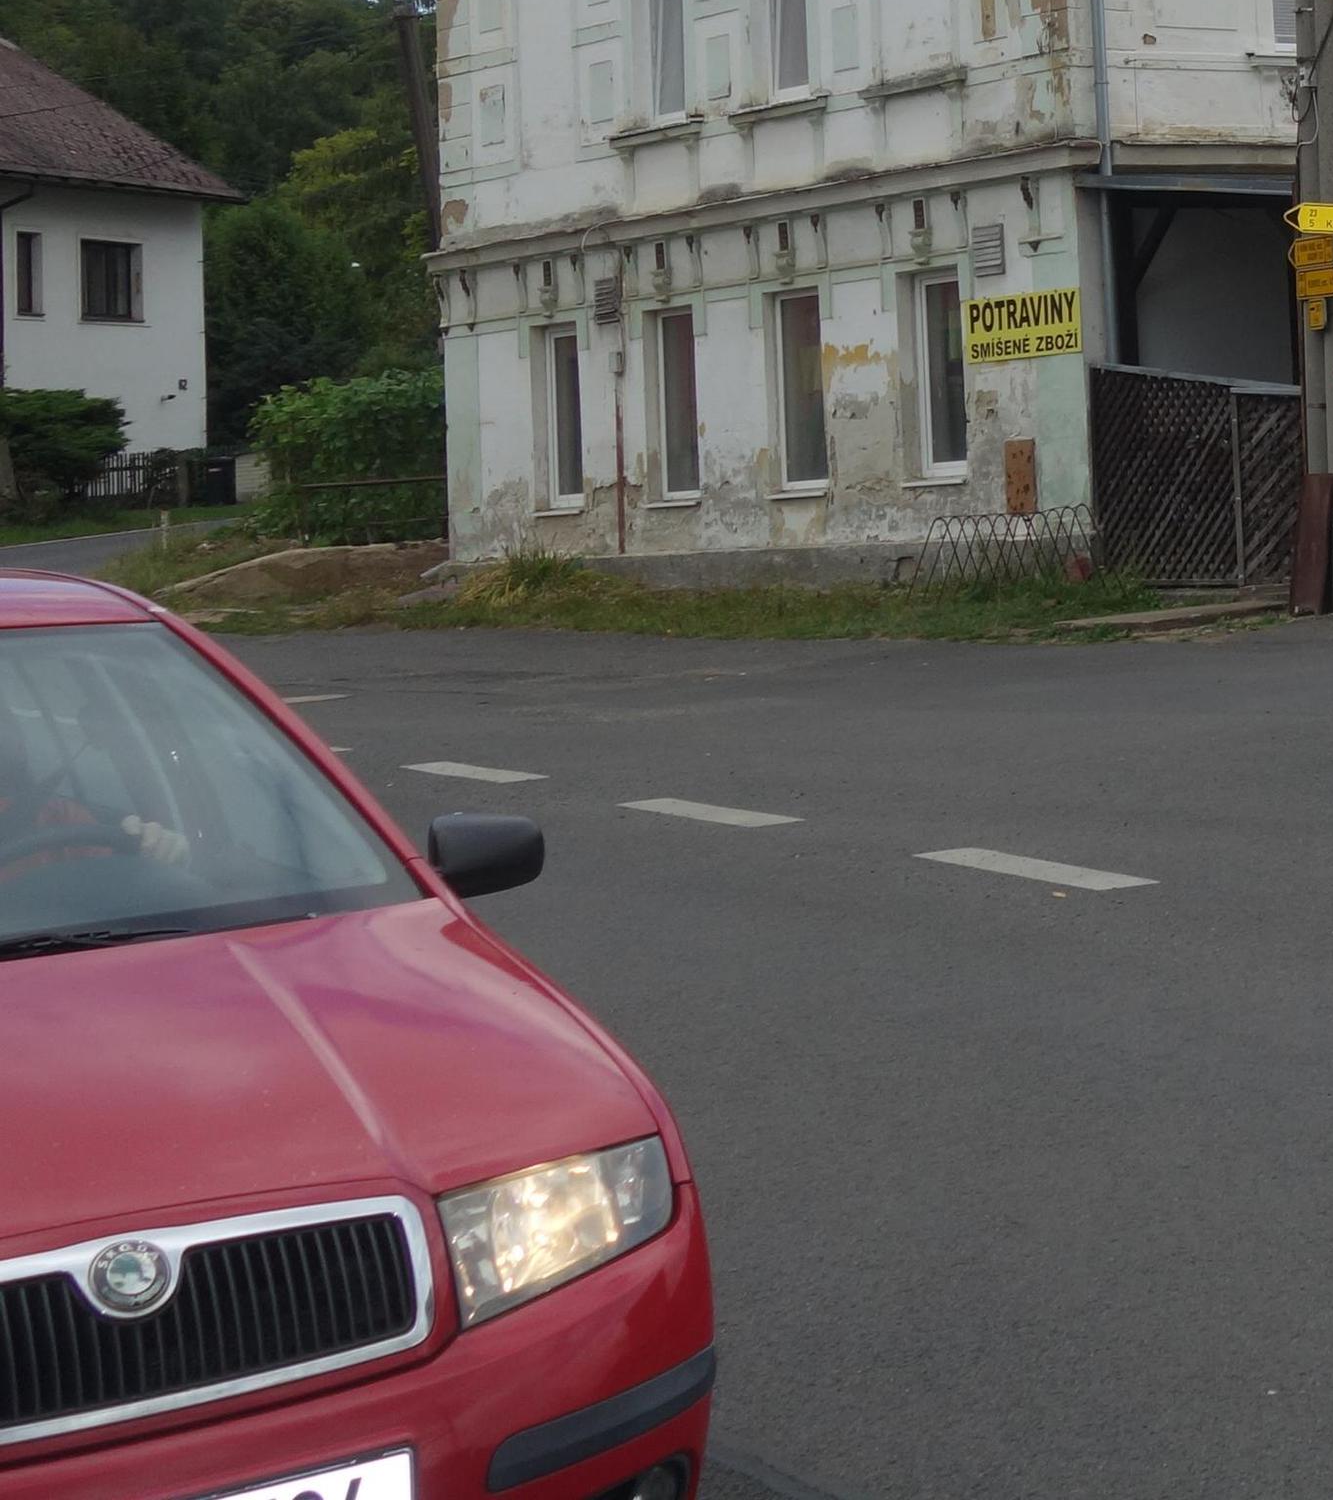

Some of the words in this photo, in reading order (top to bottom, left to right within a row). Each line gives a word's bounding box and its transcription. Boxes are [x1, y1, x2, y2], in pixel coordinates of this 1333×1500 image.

[1309, 219, 1315, 227] 5
[969, 291, 1076, 334] POTRAVINY
[971, 334, 1031, 359] SMÍŠENÉ
[1036, 328, 1078, 352] ZBOŽÍ
